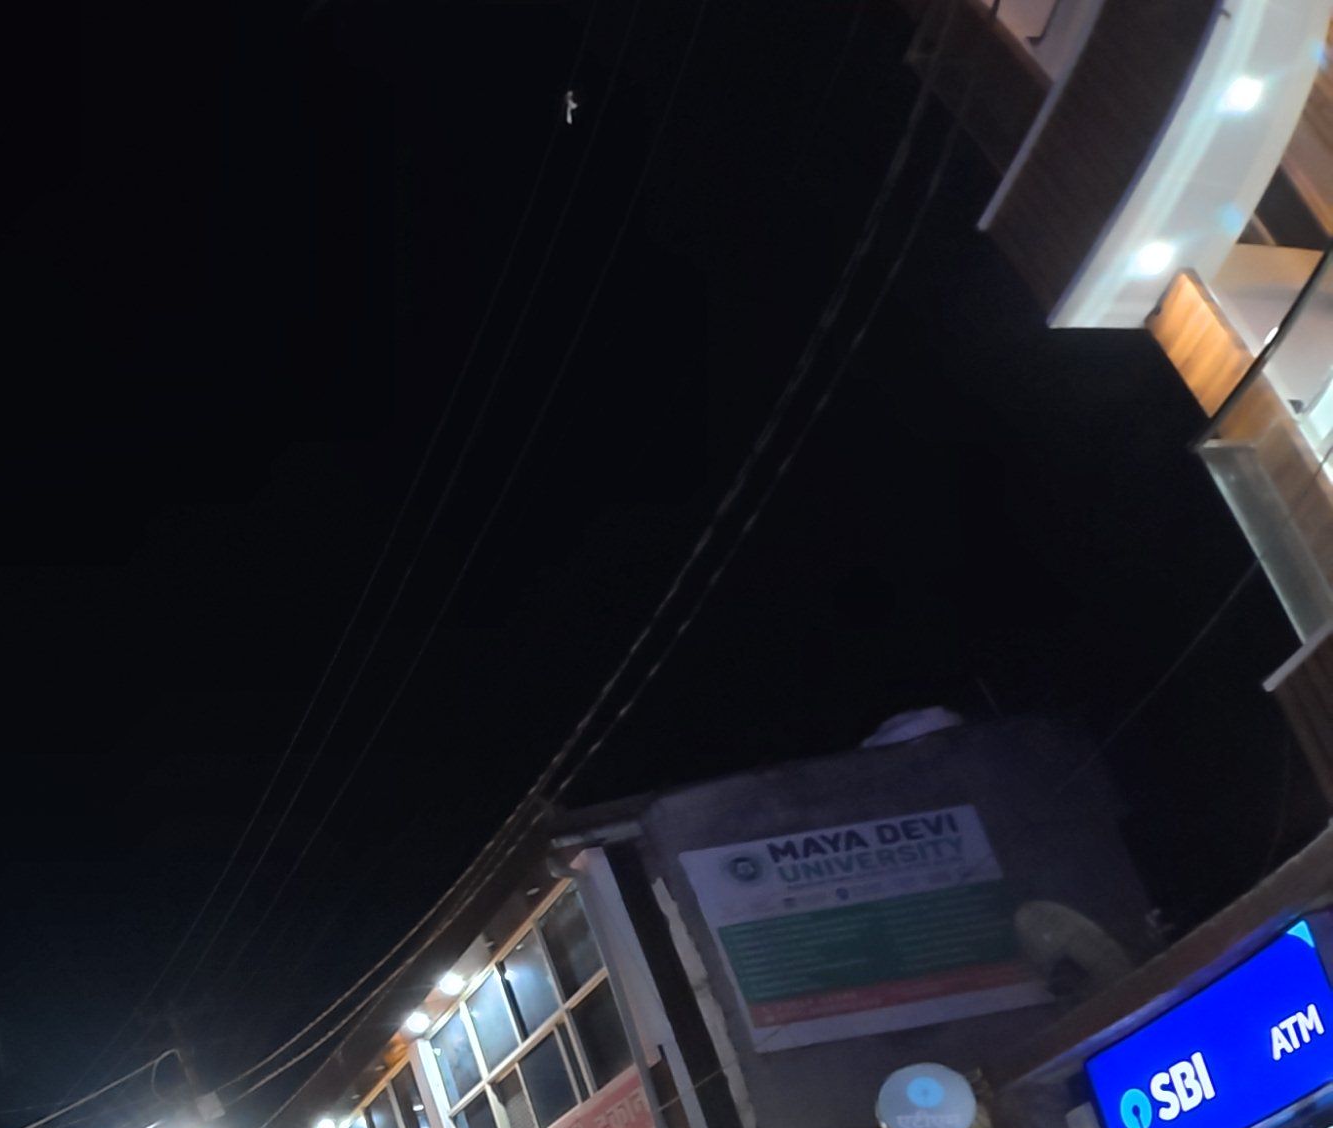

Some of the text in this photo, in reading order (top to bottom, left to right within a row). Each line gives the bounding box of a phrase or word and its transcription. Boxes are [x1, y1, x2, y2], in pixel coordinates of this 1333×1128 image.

[766, 812, 960, 863] MAYA DEVI
[775, 835, 965, 883] UNIVERSITY
[1270, 1003, 1325, 1061] ATM
[1150, 1051, 1216, 1121] SBI
